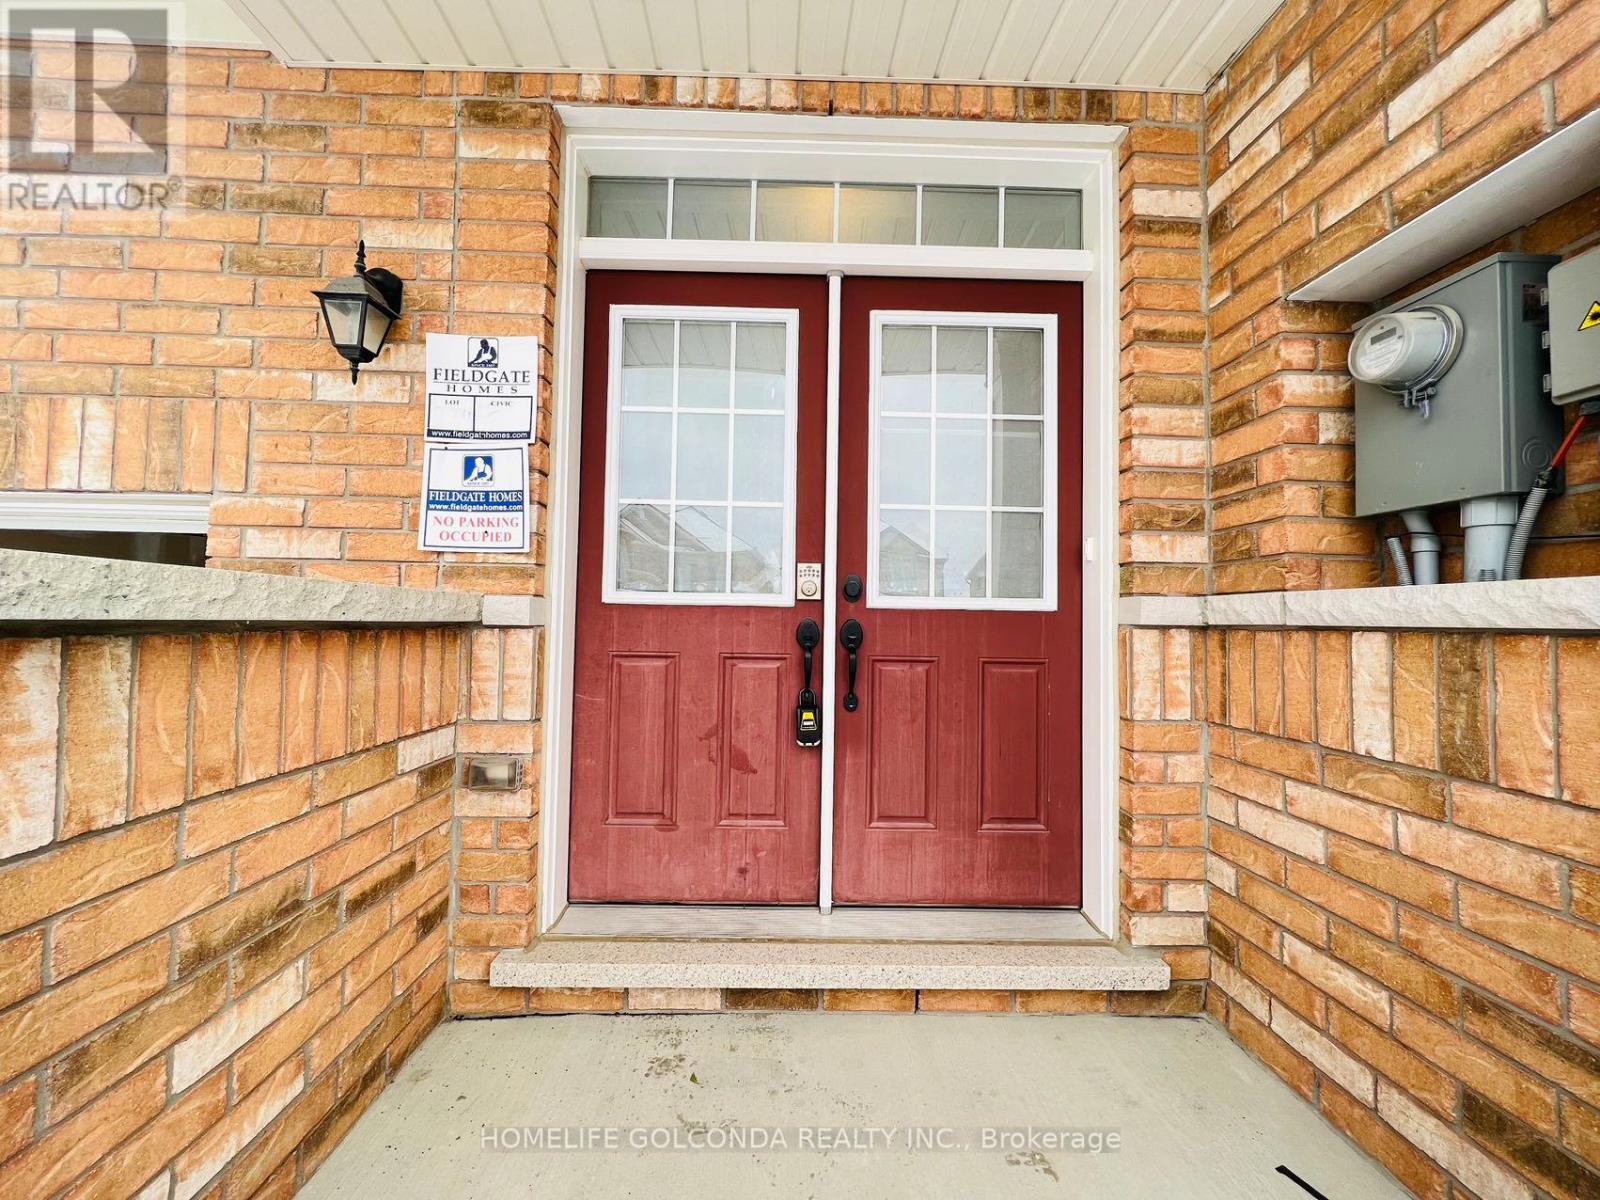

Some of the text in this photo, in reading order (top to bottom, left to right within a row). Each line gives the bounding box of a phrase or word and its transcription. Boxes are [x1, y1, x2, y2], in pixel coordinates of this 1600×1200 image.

[433, 368, 530, 383] FIELDGATE
[446, 384, 518, 394] HOMES
[429, 491, 523, 502] FIELDGATE HOMES
[428, 502, 523, 512] www.fieldgatehomes.com
[433, 515, 519, 528] NO PARKING
[439, 530, 513, 543] OCCUPIED
